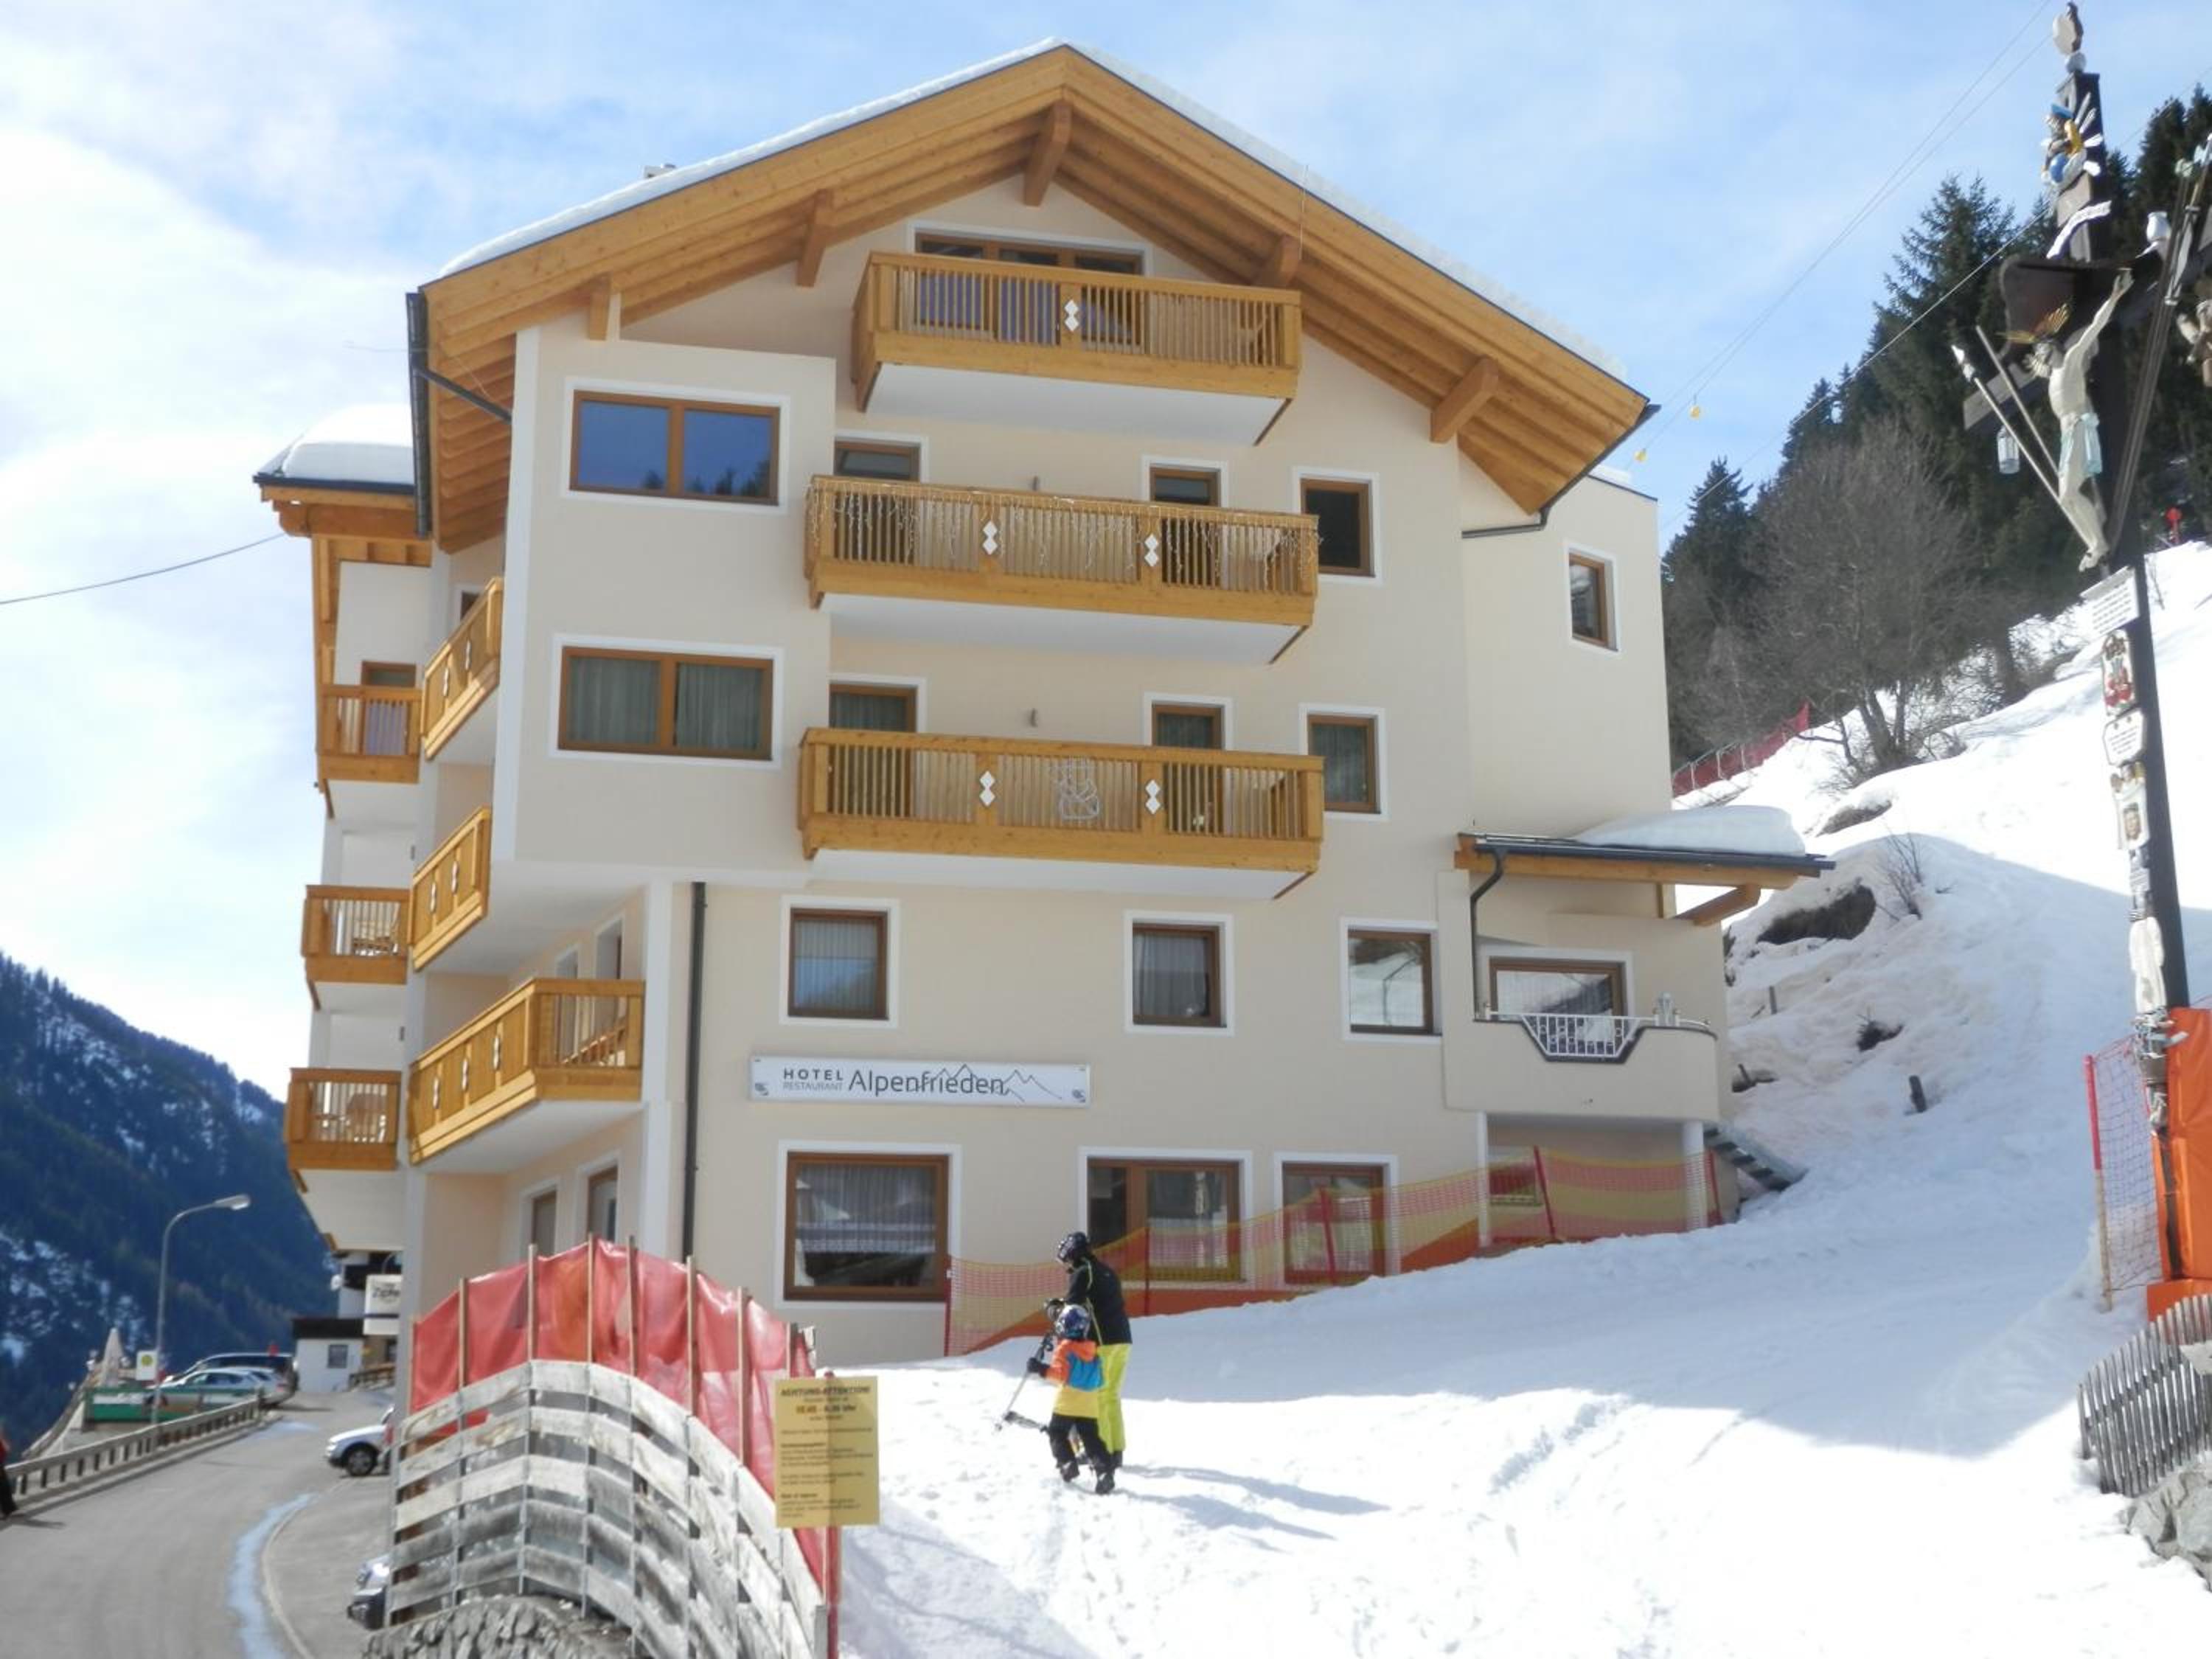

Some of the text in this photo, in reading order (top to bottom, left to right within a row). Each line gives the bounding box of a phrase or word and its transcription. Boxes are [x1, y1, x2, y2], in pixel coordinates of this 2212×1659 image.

[783, 1068, 844, 1082] HOTEL
[783, 1082, 842, 1091] RESTAURANT
[849, 1069, 1004, 1097] Alpenfrieden
